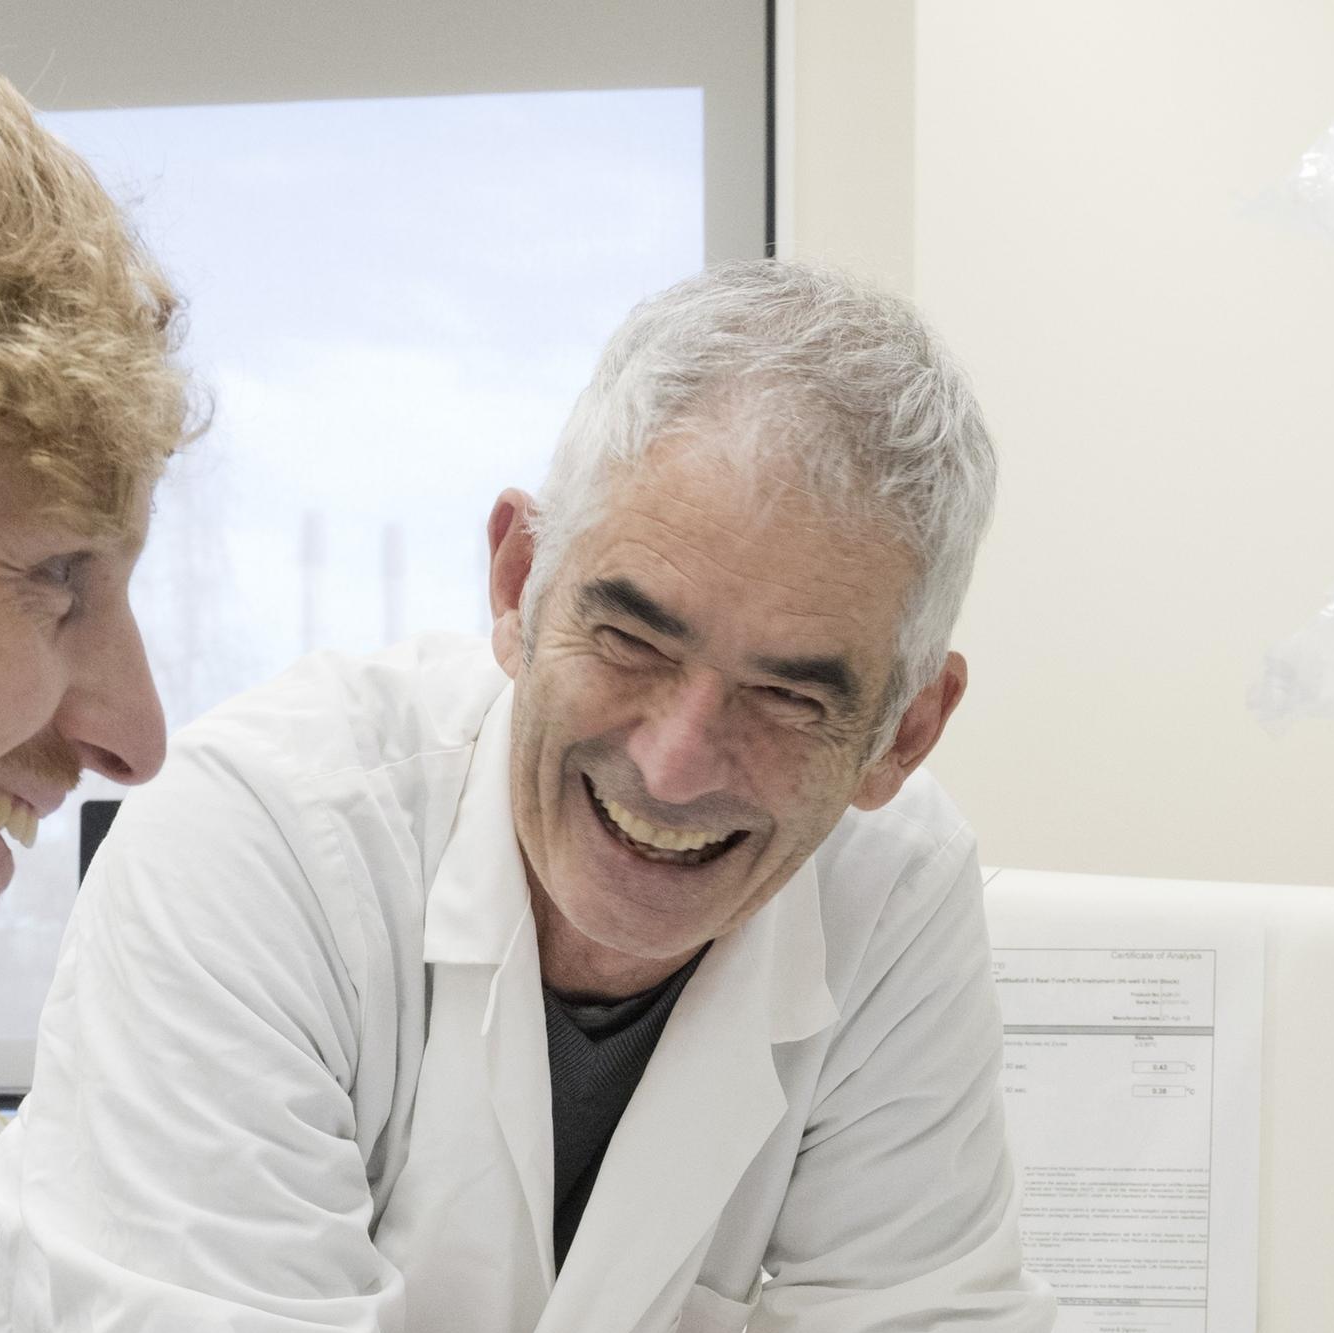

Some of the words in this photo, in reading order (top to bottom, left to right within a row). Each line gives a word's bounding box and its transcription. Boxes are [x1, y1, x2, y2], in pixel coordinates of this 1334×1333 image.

[1111, 951, 1154, 960] Certificate
[1156, 951, 1164, 960] of
[1166, 952, 1203, 961] Analysis
